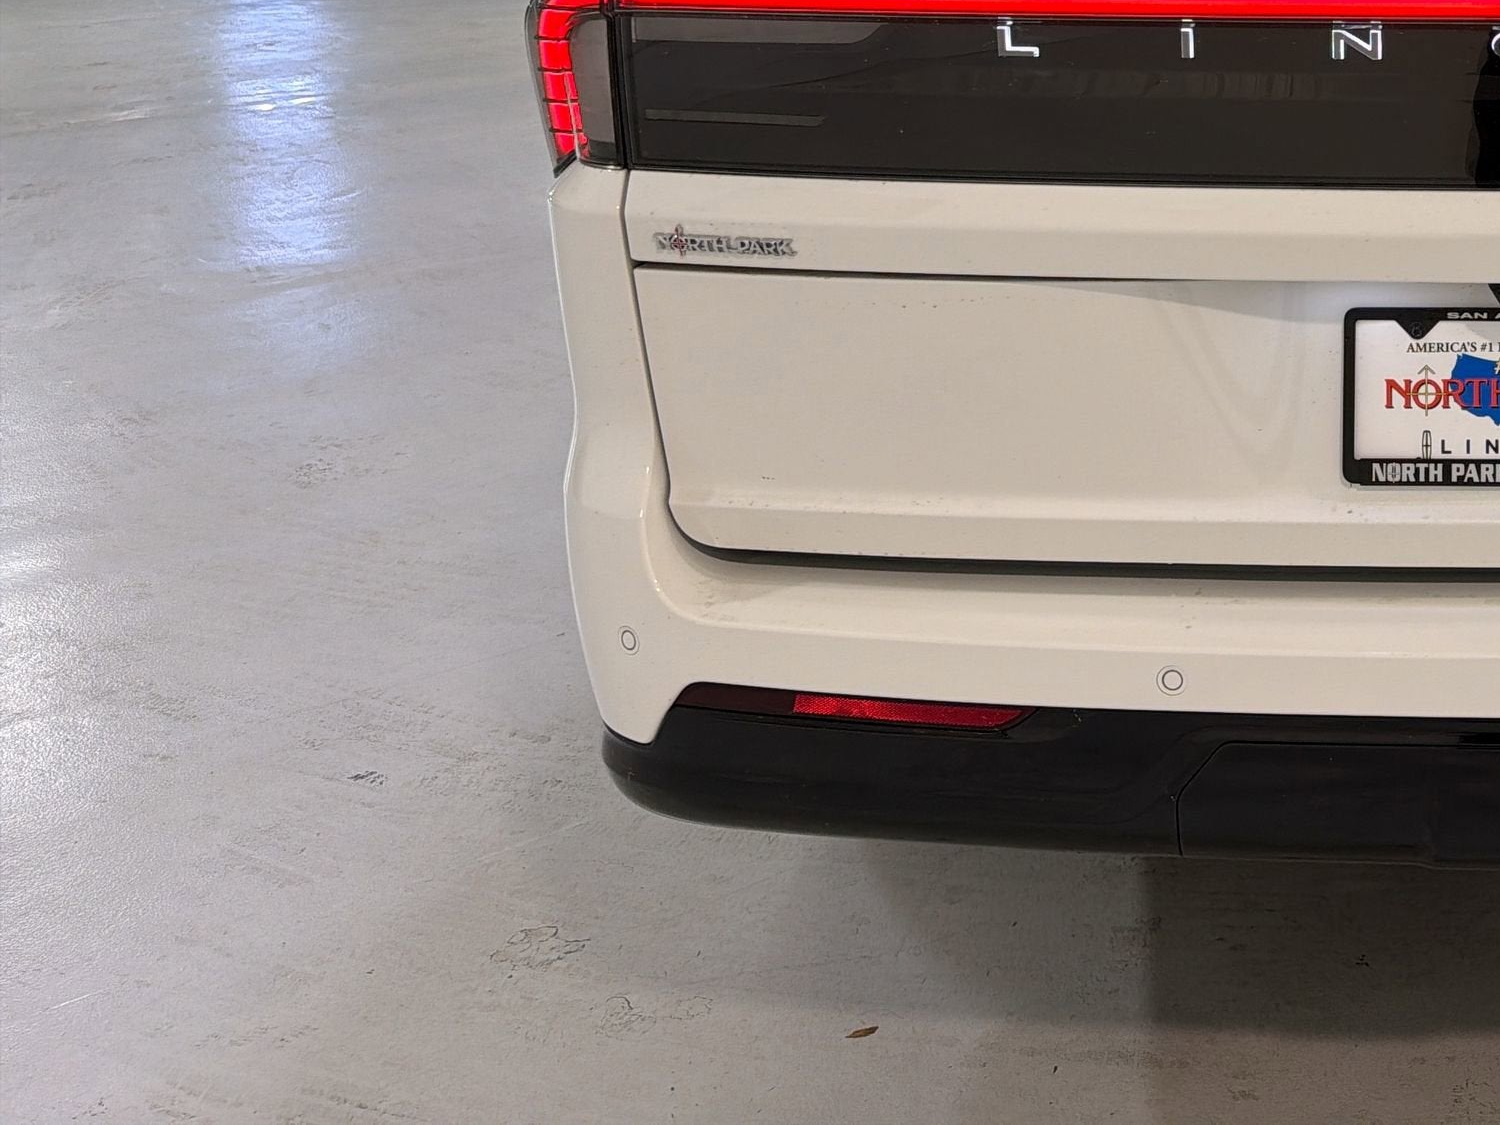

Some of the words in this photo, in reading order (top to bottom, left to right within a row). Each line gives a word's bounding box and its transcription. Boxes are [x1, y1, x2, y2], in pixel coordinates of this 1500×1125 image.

[655, 233, 730, 254] NORTH
[735, 238, 797, 257] PARK
[1447, 312, 1489, 321] SAN
[1406, 341, 1477, 353] AMERICA'S
[1480, 342, 1494, 353] #1
[1372, 462, 1443, 483] NORTH
